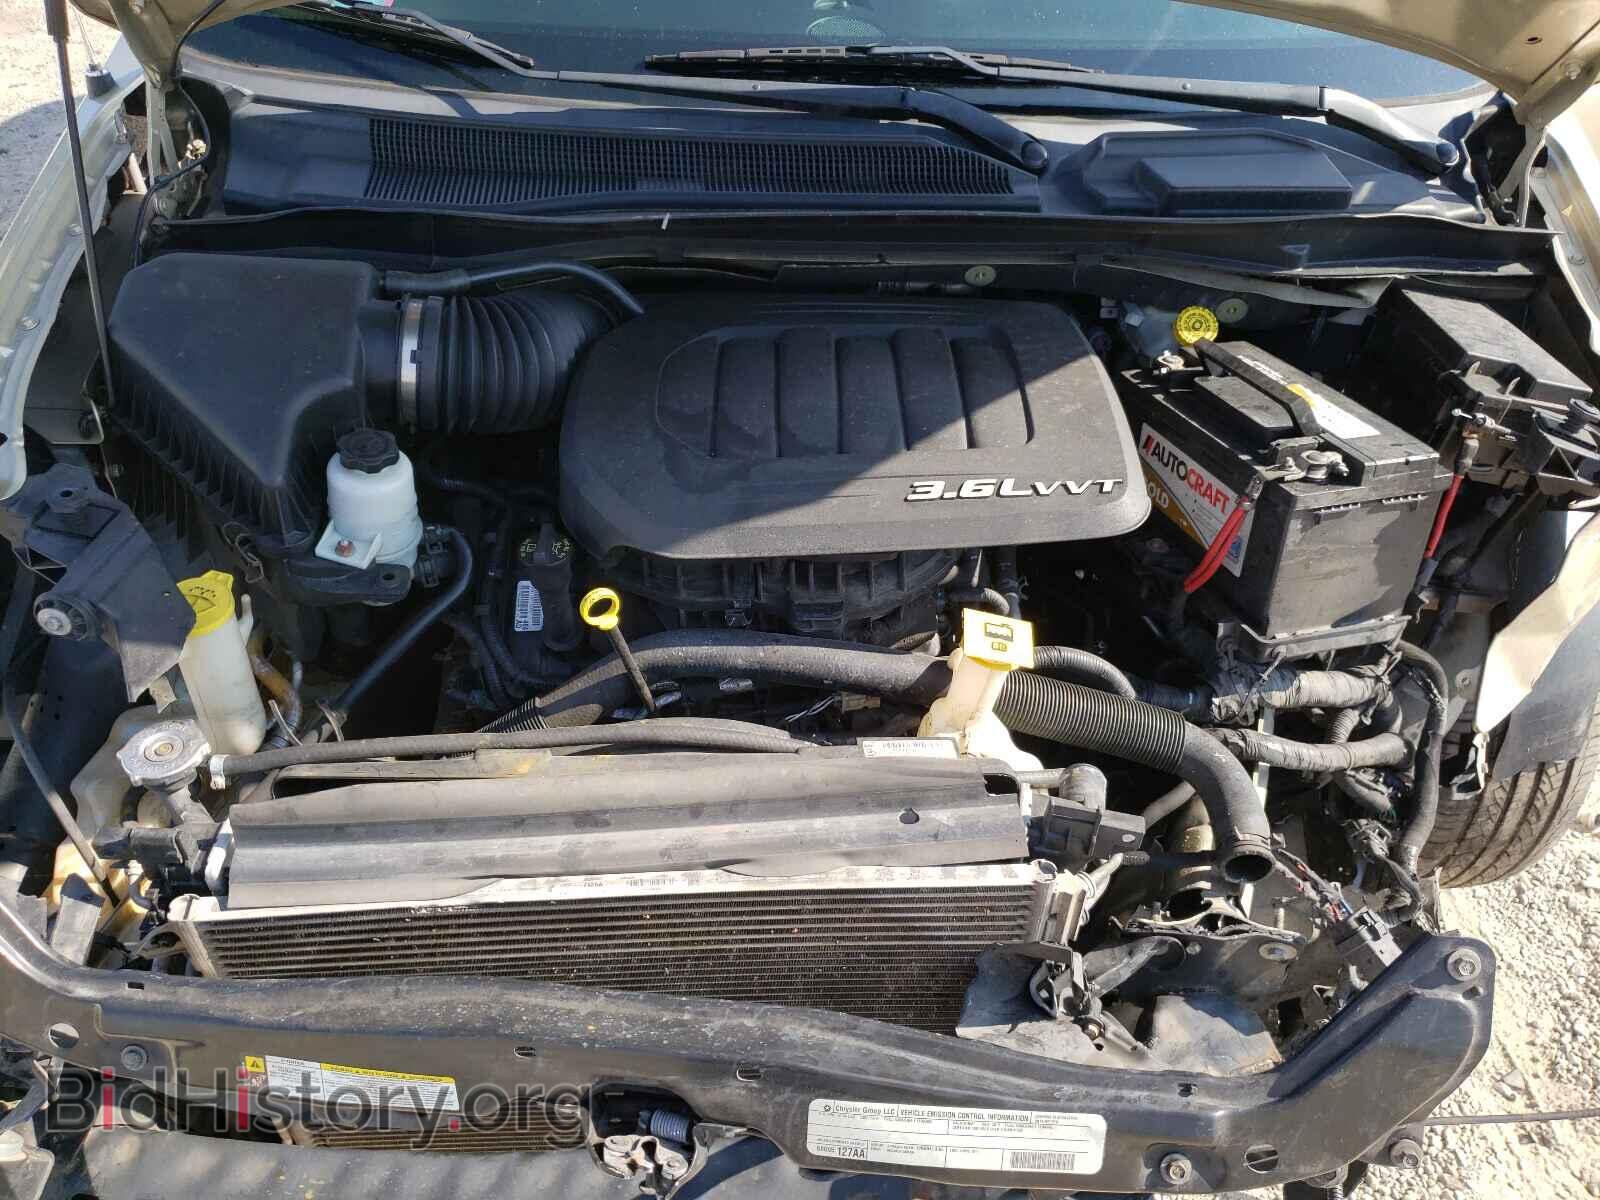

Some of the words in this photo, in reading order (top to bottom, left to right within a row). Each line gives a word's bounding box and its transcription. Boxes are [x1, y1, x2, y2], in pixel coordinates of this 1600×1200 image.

[1151, 441, 1230, 515] AUTOCRAFT
[1147, 481, 1169, 508] OLD
[835, 1105, 861, 1113] Chrysler
[862, 1106, 882, 1115] Group
[900, 1109, 925, 1117] VEHICLE
[926, 1110, 956, 1119] EMISSION
[957, 1112, 985, 1120] CONTROL
[987, 1113, 1029, 1122] INFORMATION
[837, 1146, 865, 1159] 127AA
